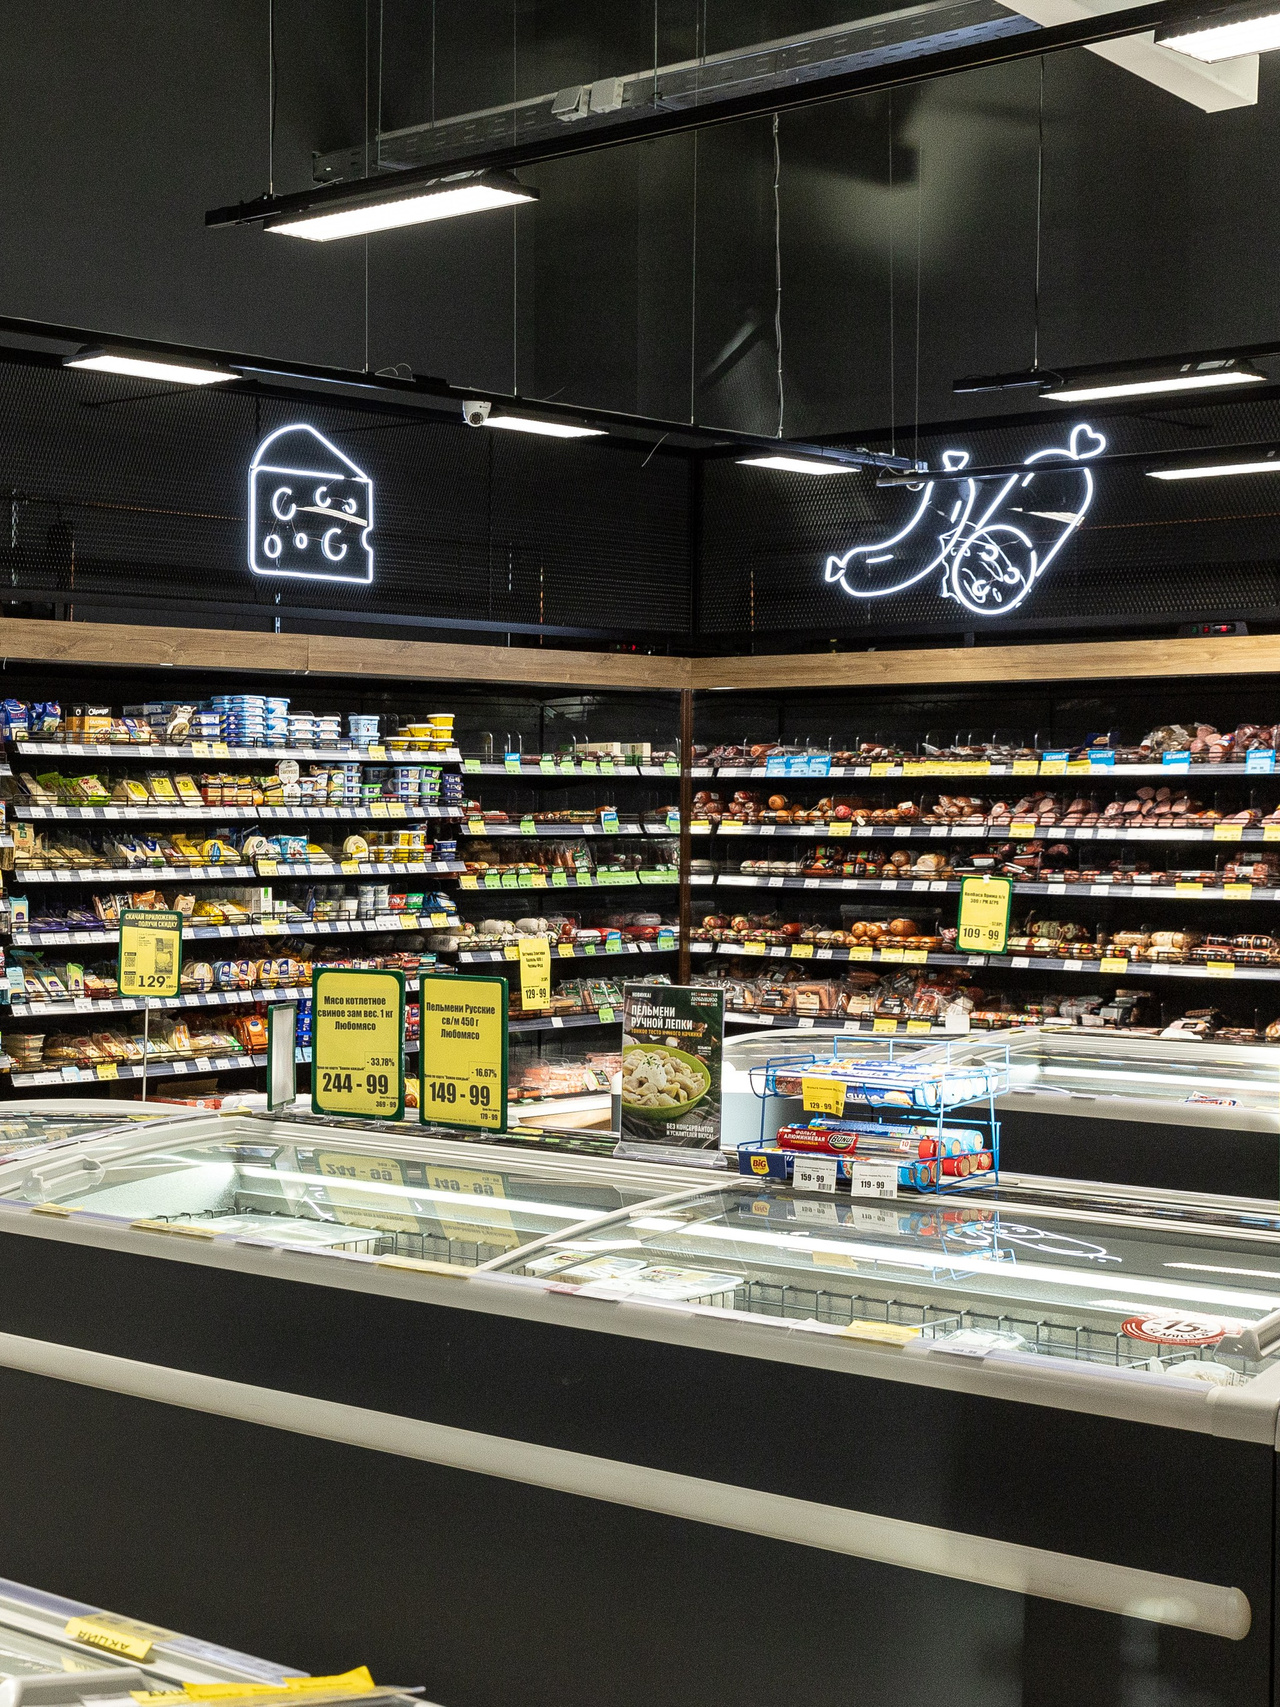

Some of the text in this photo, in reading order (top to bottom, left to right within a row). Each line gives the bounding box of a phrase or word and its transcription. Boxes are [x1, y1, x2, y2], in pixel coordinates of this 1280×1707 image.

[963, 928, 980, 938] 109
[988, 930, 999, 940] 99
[138, 975, 166, 988] 129
[525, 988, 536, 999] 129
[539, 988, 547, 998] 99
[324, 995, 386, 1006] Мясо котлетное
[317, 1009, 393, 1018] свиное зам вес. 1 кг
[426, 1002, 496, 1015] Пельмени Русские
[631, 1005, 676, 1017] ПЕЛЬМЕНИ
[334, 1021, 376, 1031] Любомясо
[442, 1016, 479, 1027] св/м 450 г
[631, 1016, 692, 1030] РУЧНОЙ ЛЕПКИ
[441, 1028, 480, 1040] Любомясо
[370, 1057, 395, 1067] 33,78%
[475, 1068, 497, 1078] 16,67%
[322, 1072, 353, 1093] 244
[366, 1074, 389, 1095] 99
[429, 1082, 456, 1103] 149
[470, 1084, 490, 1106] 99
[810, 1102, 820, 1110] 129
[824, 1103, 832, 1111] 99
[666, 1122, 714, 1133] БЕЗ КОНСЕРВАНТОВ
[784, 1134, 826, 1142] АЛЮМИНИЕВАЯ
[800, 1173, 812, 1182] 159
[816, 1175, 825, 1183] 99
[860, 1180, 871, 1188] 119
[876, 1181, 885, 1189] 99
[78, 1630, 130, 1650] АКЦИЯ
